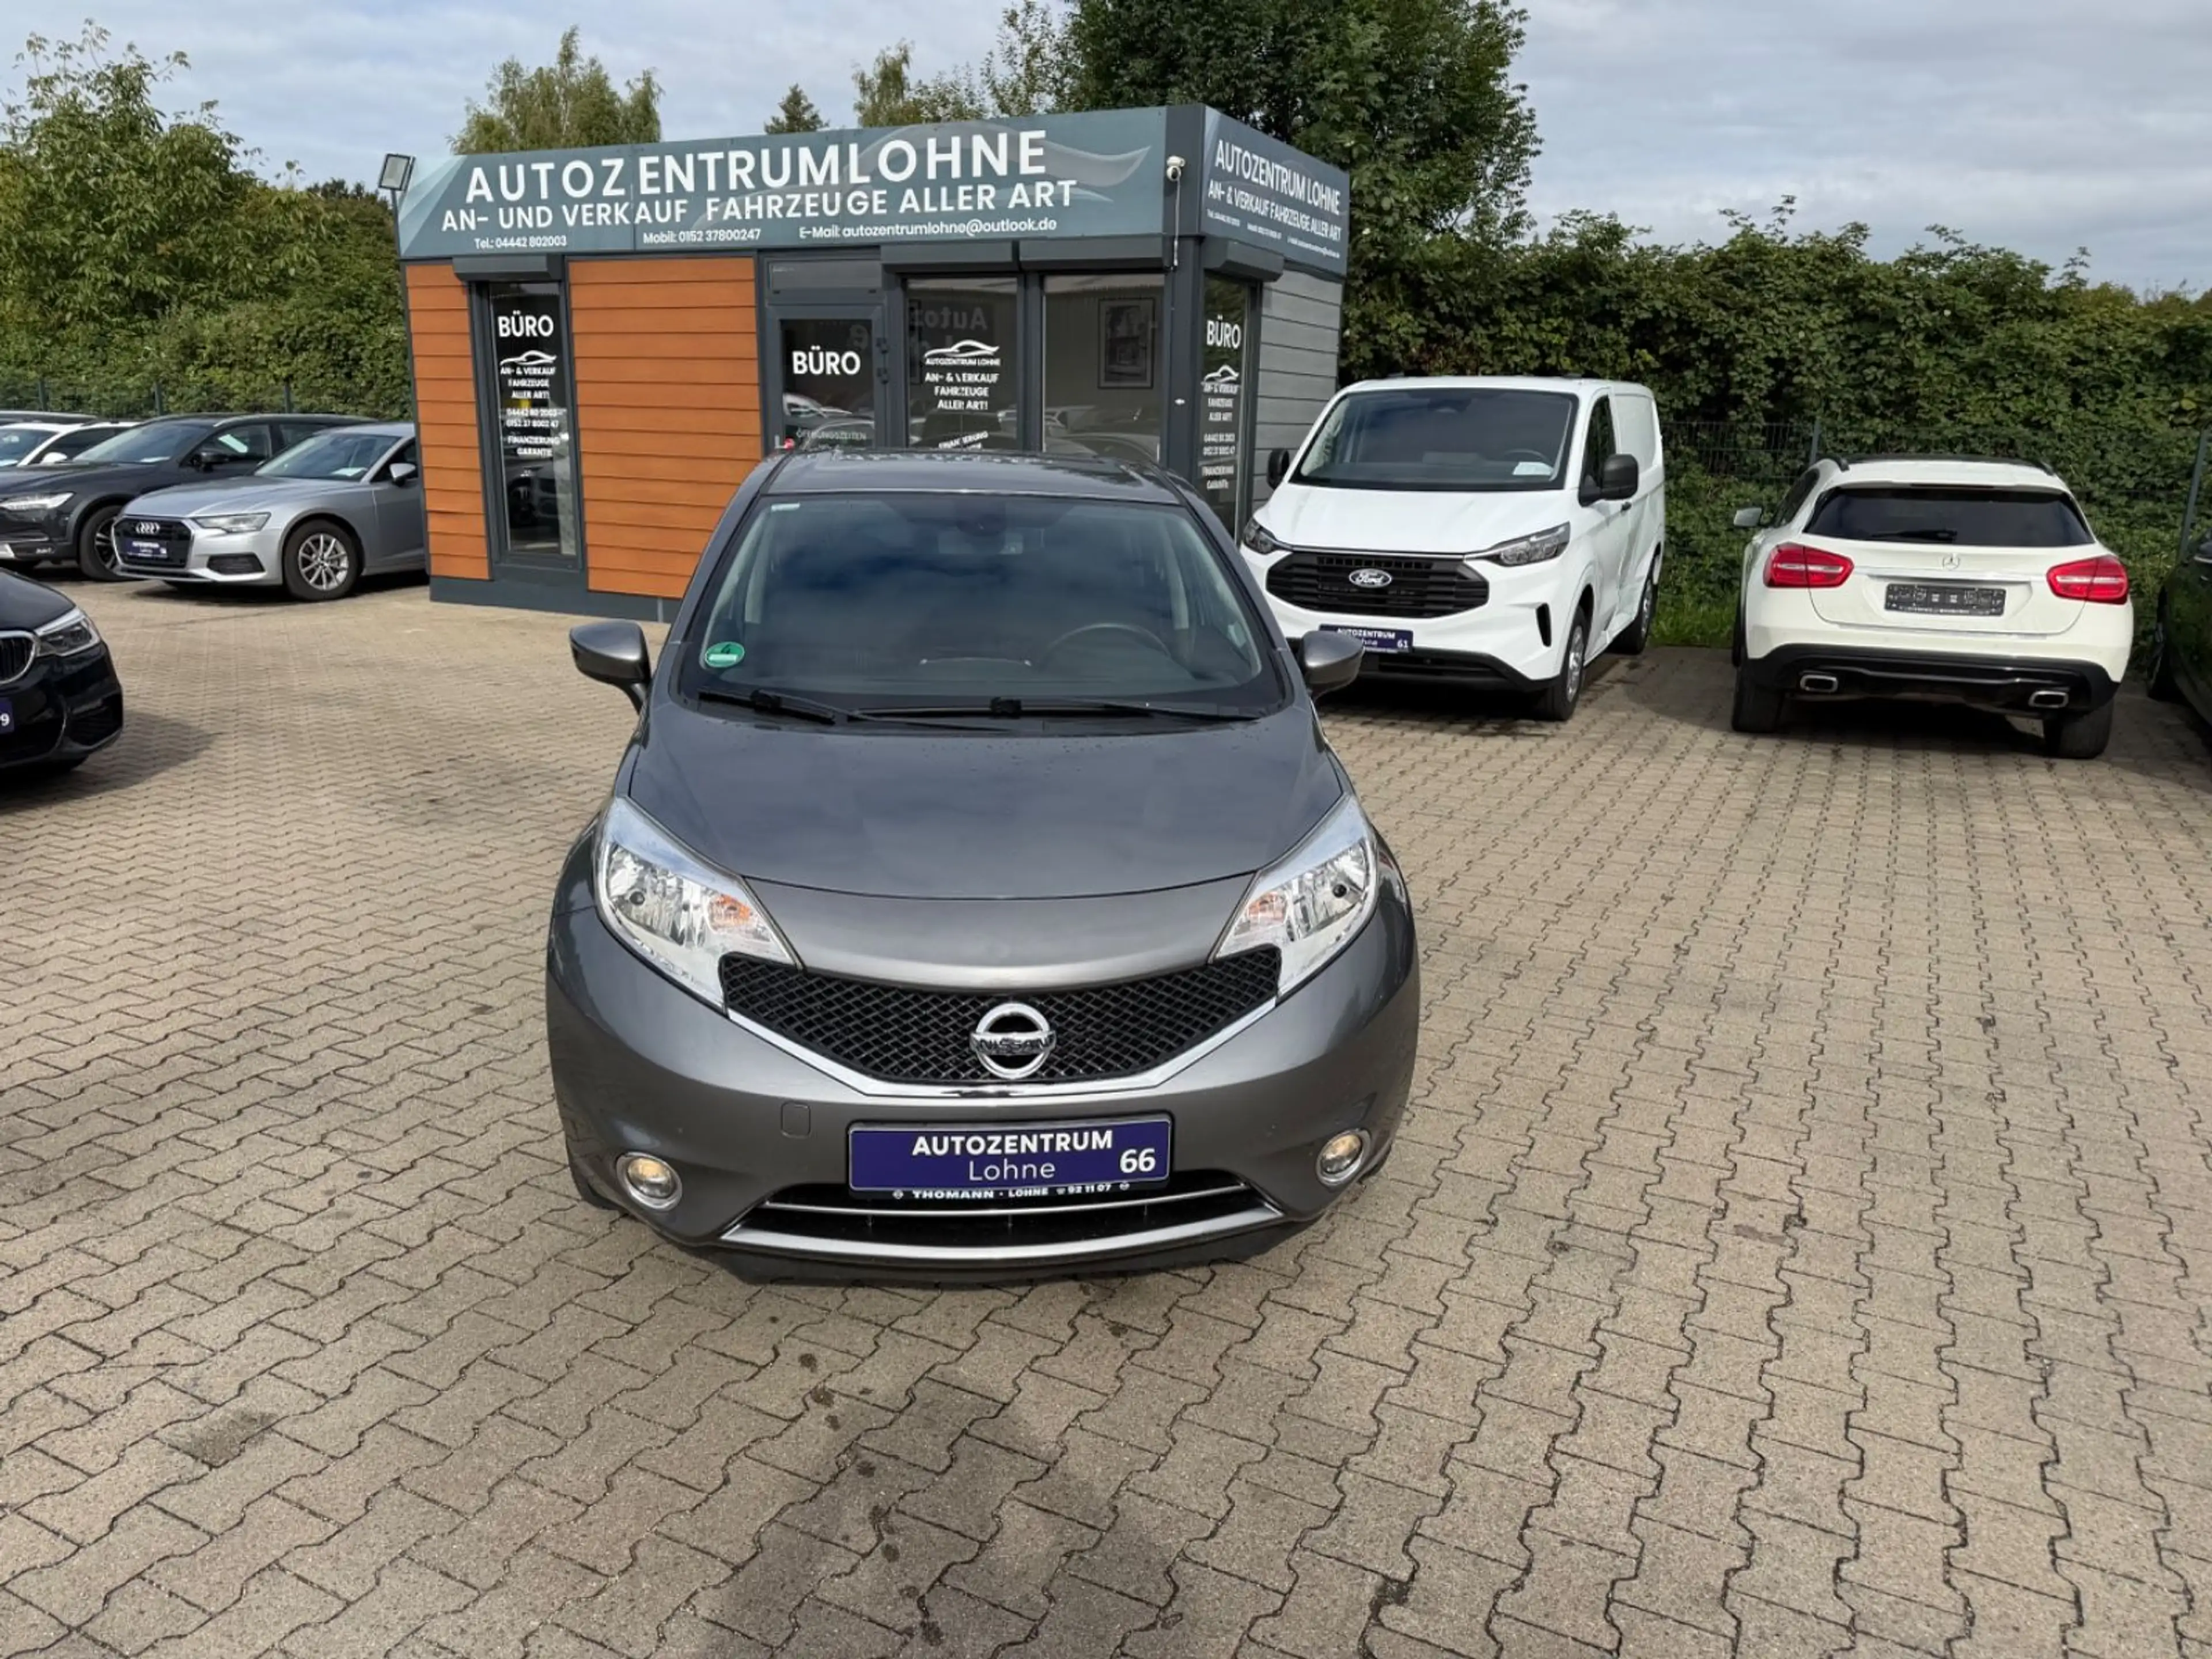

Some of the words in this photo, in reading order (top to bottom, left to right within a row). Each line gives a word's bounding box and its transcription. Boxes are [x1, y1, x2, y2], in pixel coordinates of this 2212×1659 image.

[1215, 139, 1306, 201] AUTOZENTRUM
[1307, 177, 1340, 215] LOHNE
[442, 209, 489, 231] AN-
[498, 204, 553, 229] UND
[562, 198, 687, 227] VERKAUF
[707, 189, 887, 221] FAHRZEUGE
[899, 184, 995, 214] ALLER
[1007, 180, 1077, 209] ART
[1234, 188, 1270, 217] VERKAUF
[495, 237, 527, 248] 04442
[529, 235, 567, 247] 802003
[678, 230, 703, 243] 0152
[706, 228, 761, 242] 37800247
[498, 310, 554, 337] BÜRO
[1206, 314, 1241, 349] BÜRO
[792, 344, 861, 375] BÜRO
[1397, 639, 1409, 648] 61
[0, 713, 10, 726] 9
[912, 1130, 1113, 1156] AUTOZENTRUM
[968, 1158, 1055, 1182] Lohne
[1119, 1147, 1156, 1174] 66
[912, 1190, 994, 1199] THOMANN
[1008, 1188, 1048, 1198] LOHNE
[1067, 1185, 1082, 1195] 92
[1097, 1183, 1112, 1192] 07
